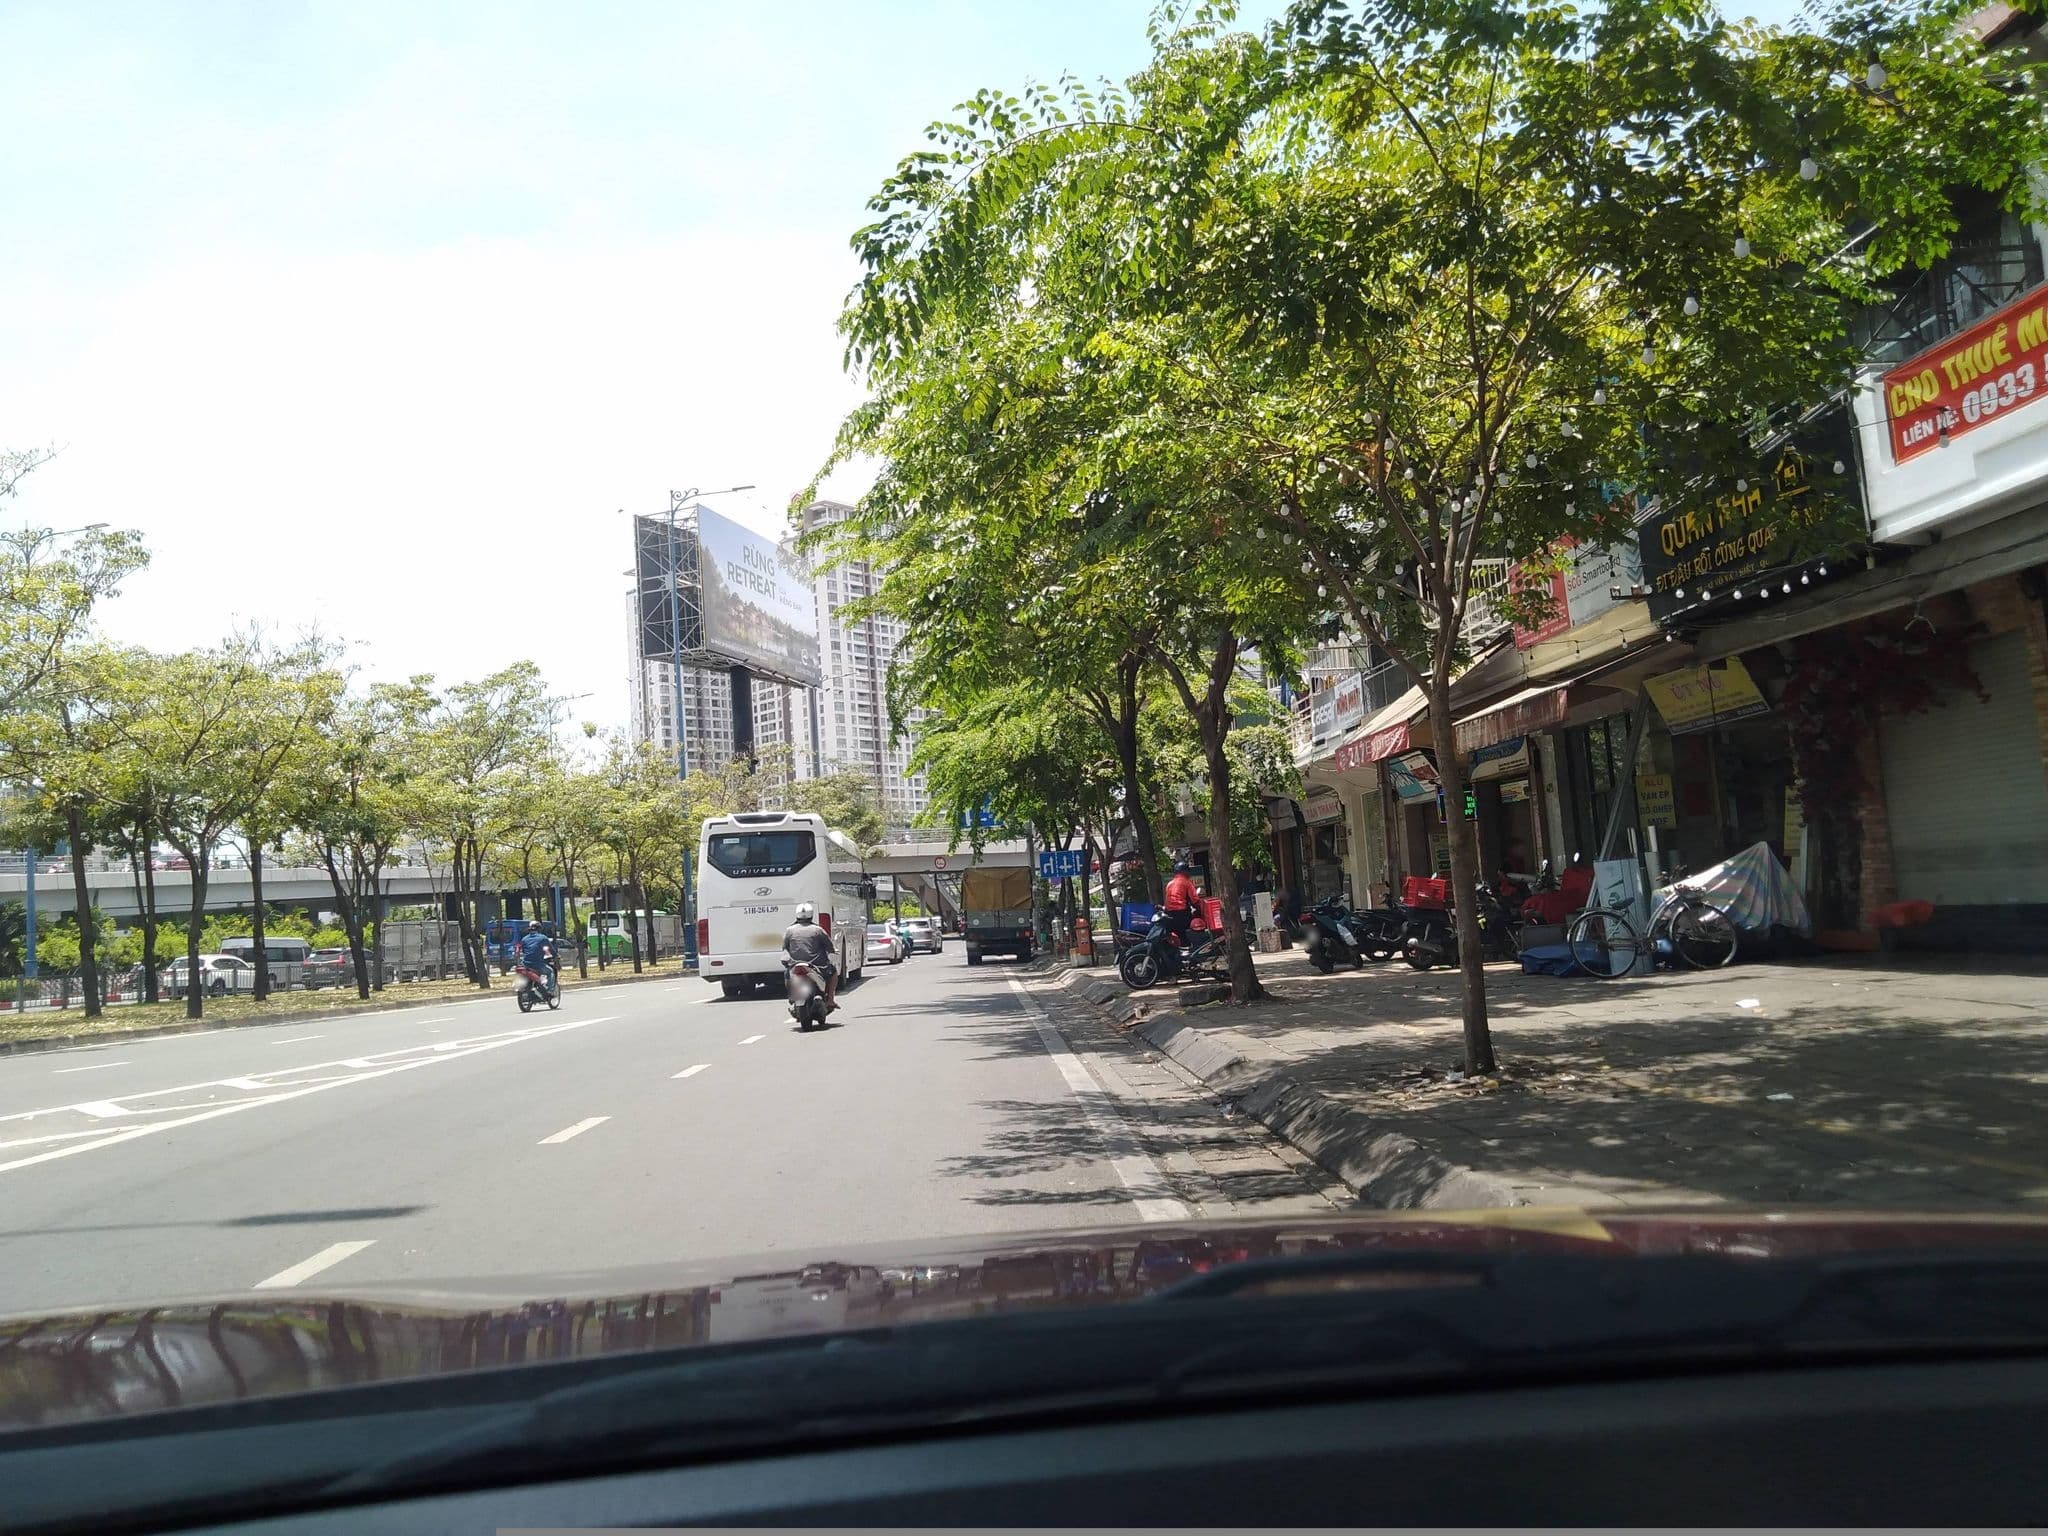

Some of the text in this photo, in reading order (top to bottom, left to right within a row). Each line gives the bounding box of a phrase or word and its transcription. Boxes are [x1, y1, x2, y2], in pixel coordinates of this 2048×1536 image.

[1890, 369, 1940, 418] CHO
[1941, 323, 2012, 391] THUÊ
[2016, 307, 2048, 353] M
[1902, 420, 1934, 447] LIÊN
[1962, 363, 2035, 424] 0933
[727, 561, 777, 601] RETREAT
[1567, 575, 1582, 592] SCG
[1656, 573, 1668, 594] ĐI
[1668, 561, 1692, 588] ĐÂU
[1714, 538, 1745, 567] CŨNG
[733, 867, 792, 875] UNIVERSE
